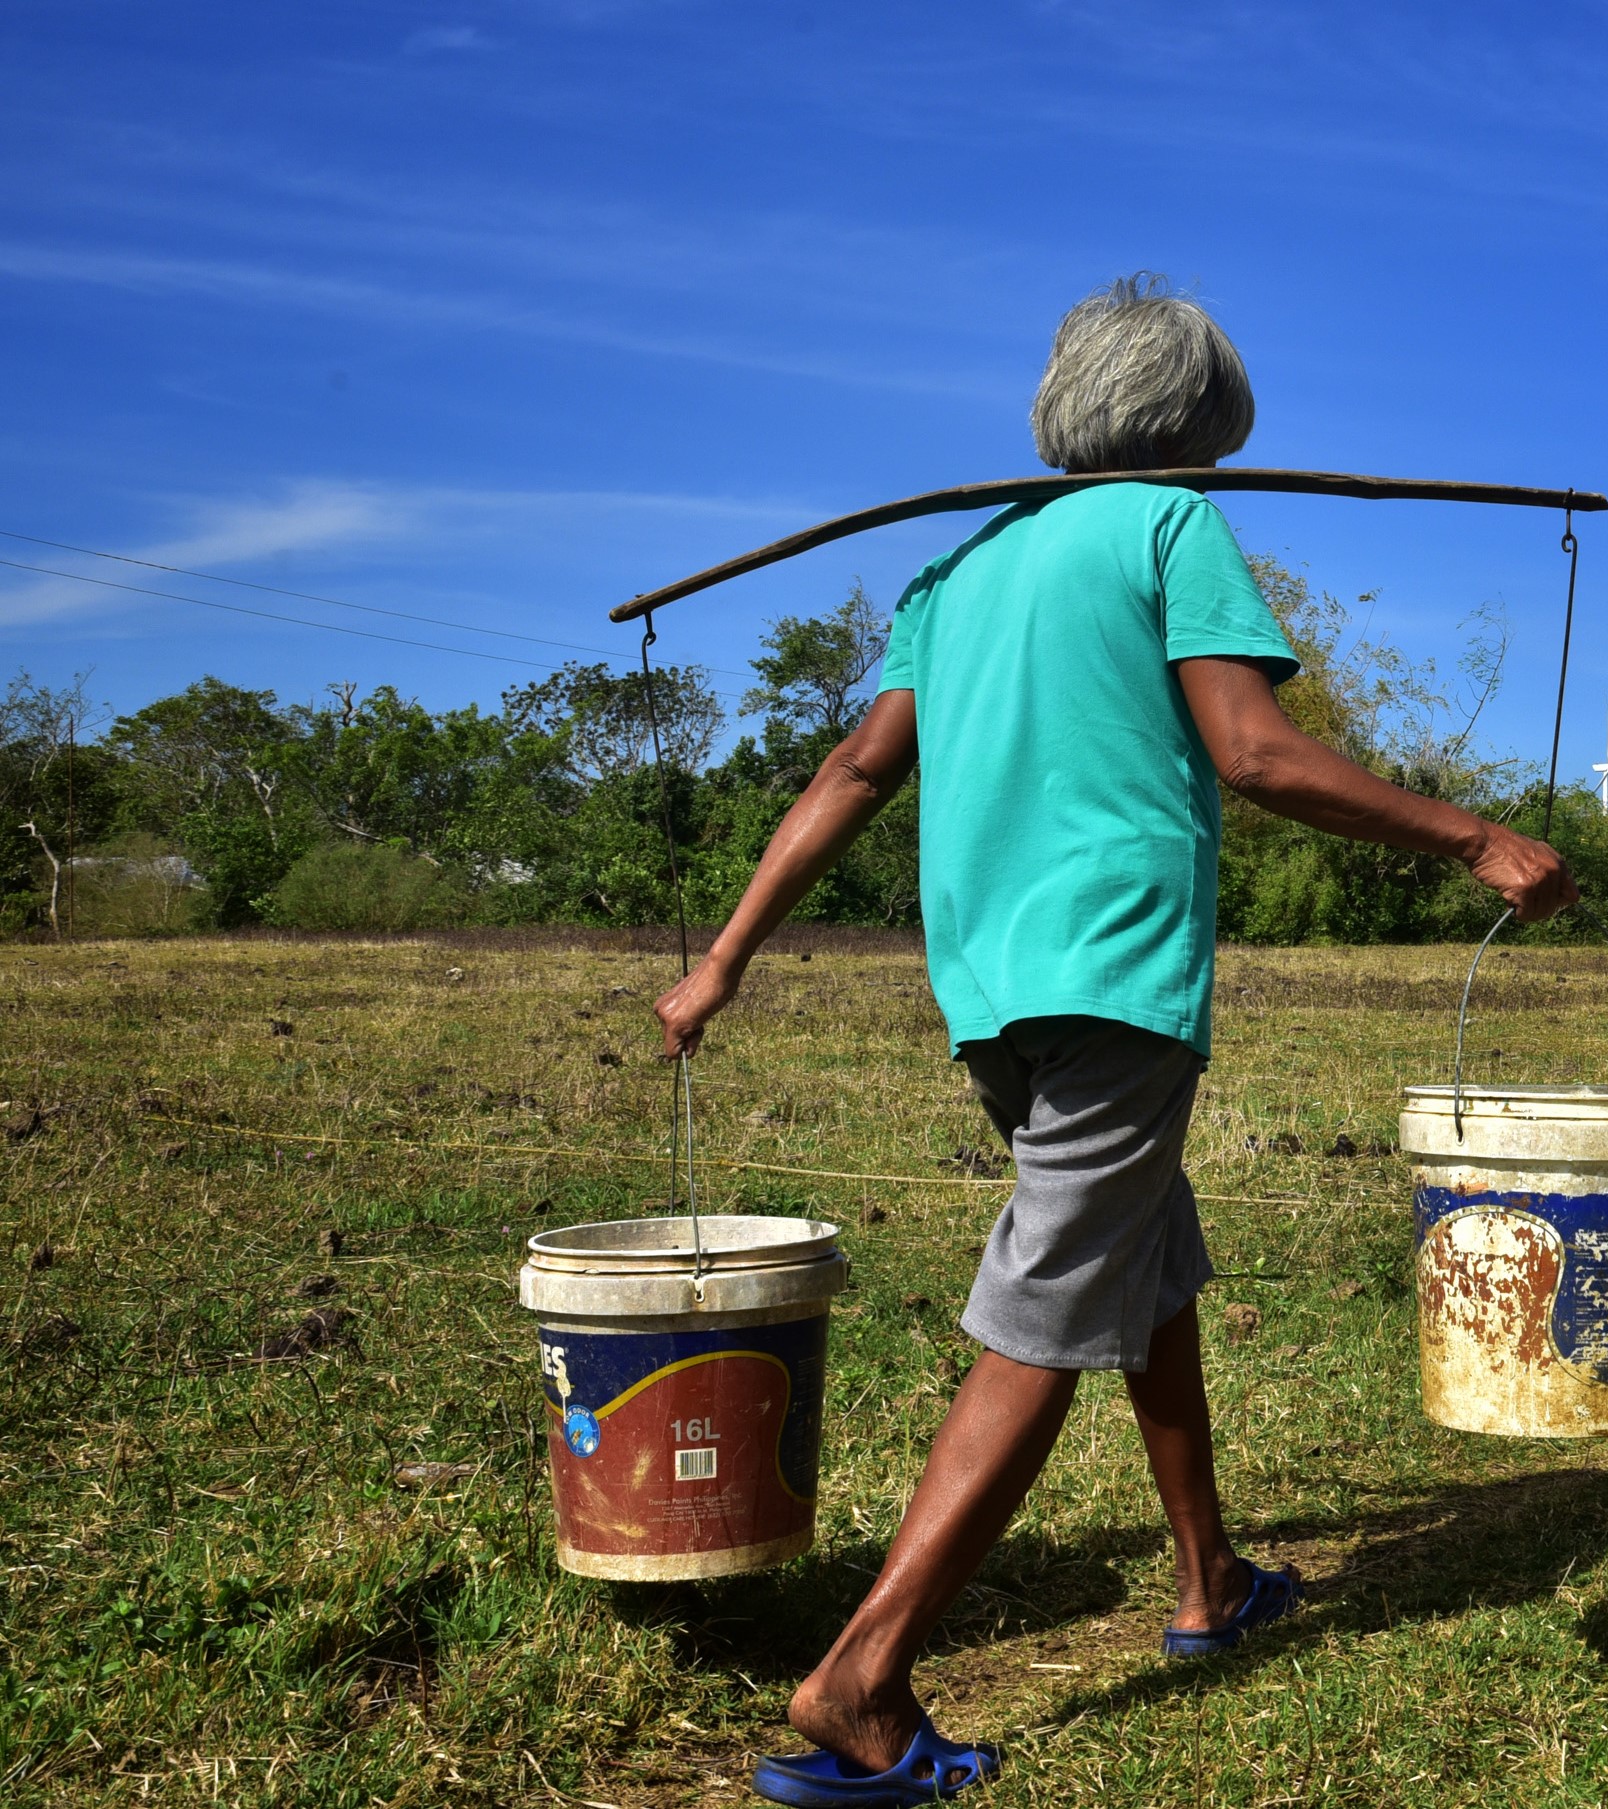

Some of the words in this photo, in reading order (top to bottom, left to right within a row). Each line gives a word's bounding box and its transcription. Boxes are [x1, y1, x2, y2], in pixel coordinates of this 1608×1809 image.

[670, 1417, 721, 1442] 16L
[648, 1498, 671, 1506] Davies
[672, 1497, 692, 1505] Paints
